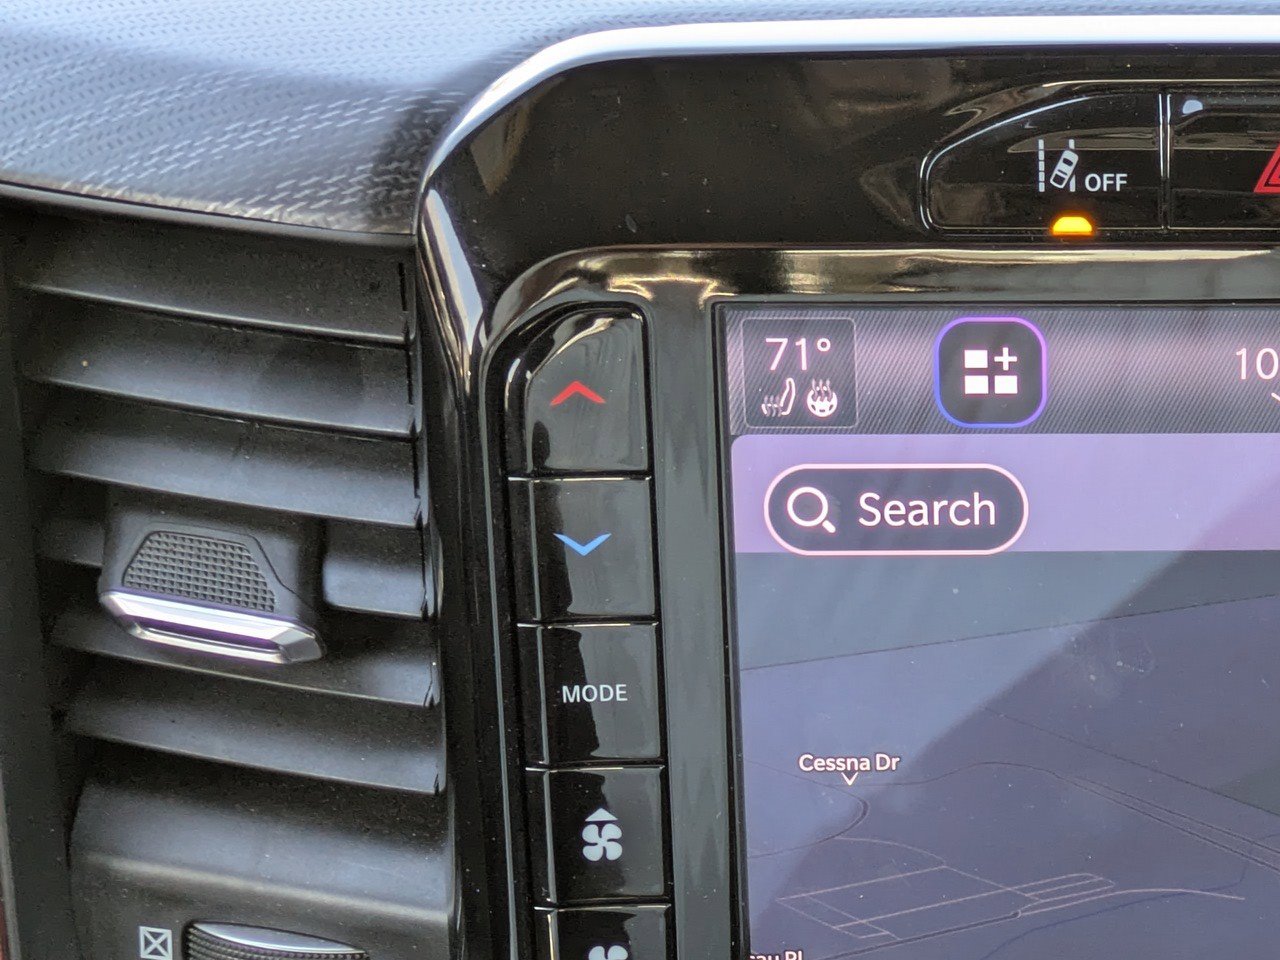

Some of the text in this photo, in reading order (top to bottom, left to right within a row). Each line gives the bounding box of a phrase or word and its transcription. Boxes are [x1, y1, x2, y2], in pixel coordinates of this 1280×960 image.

[1084, 173, 1128, 192] OFF
[765, 337, 831, 371] 71°
[858, 491, 996, 527] Search
[562, 683, 629, 703] MODE
[798, 753, 900, 772] Cessna Dr
